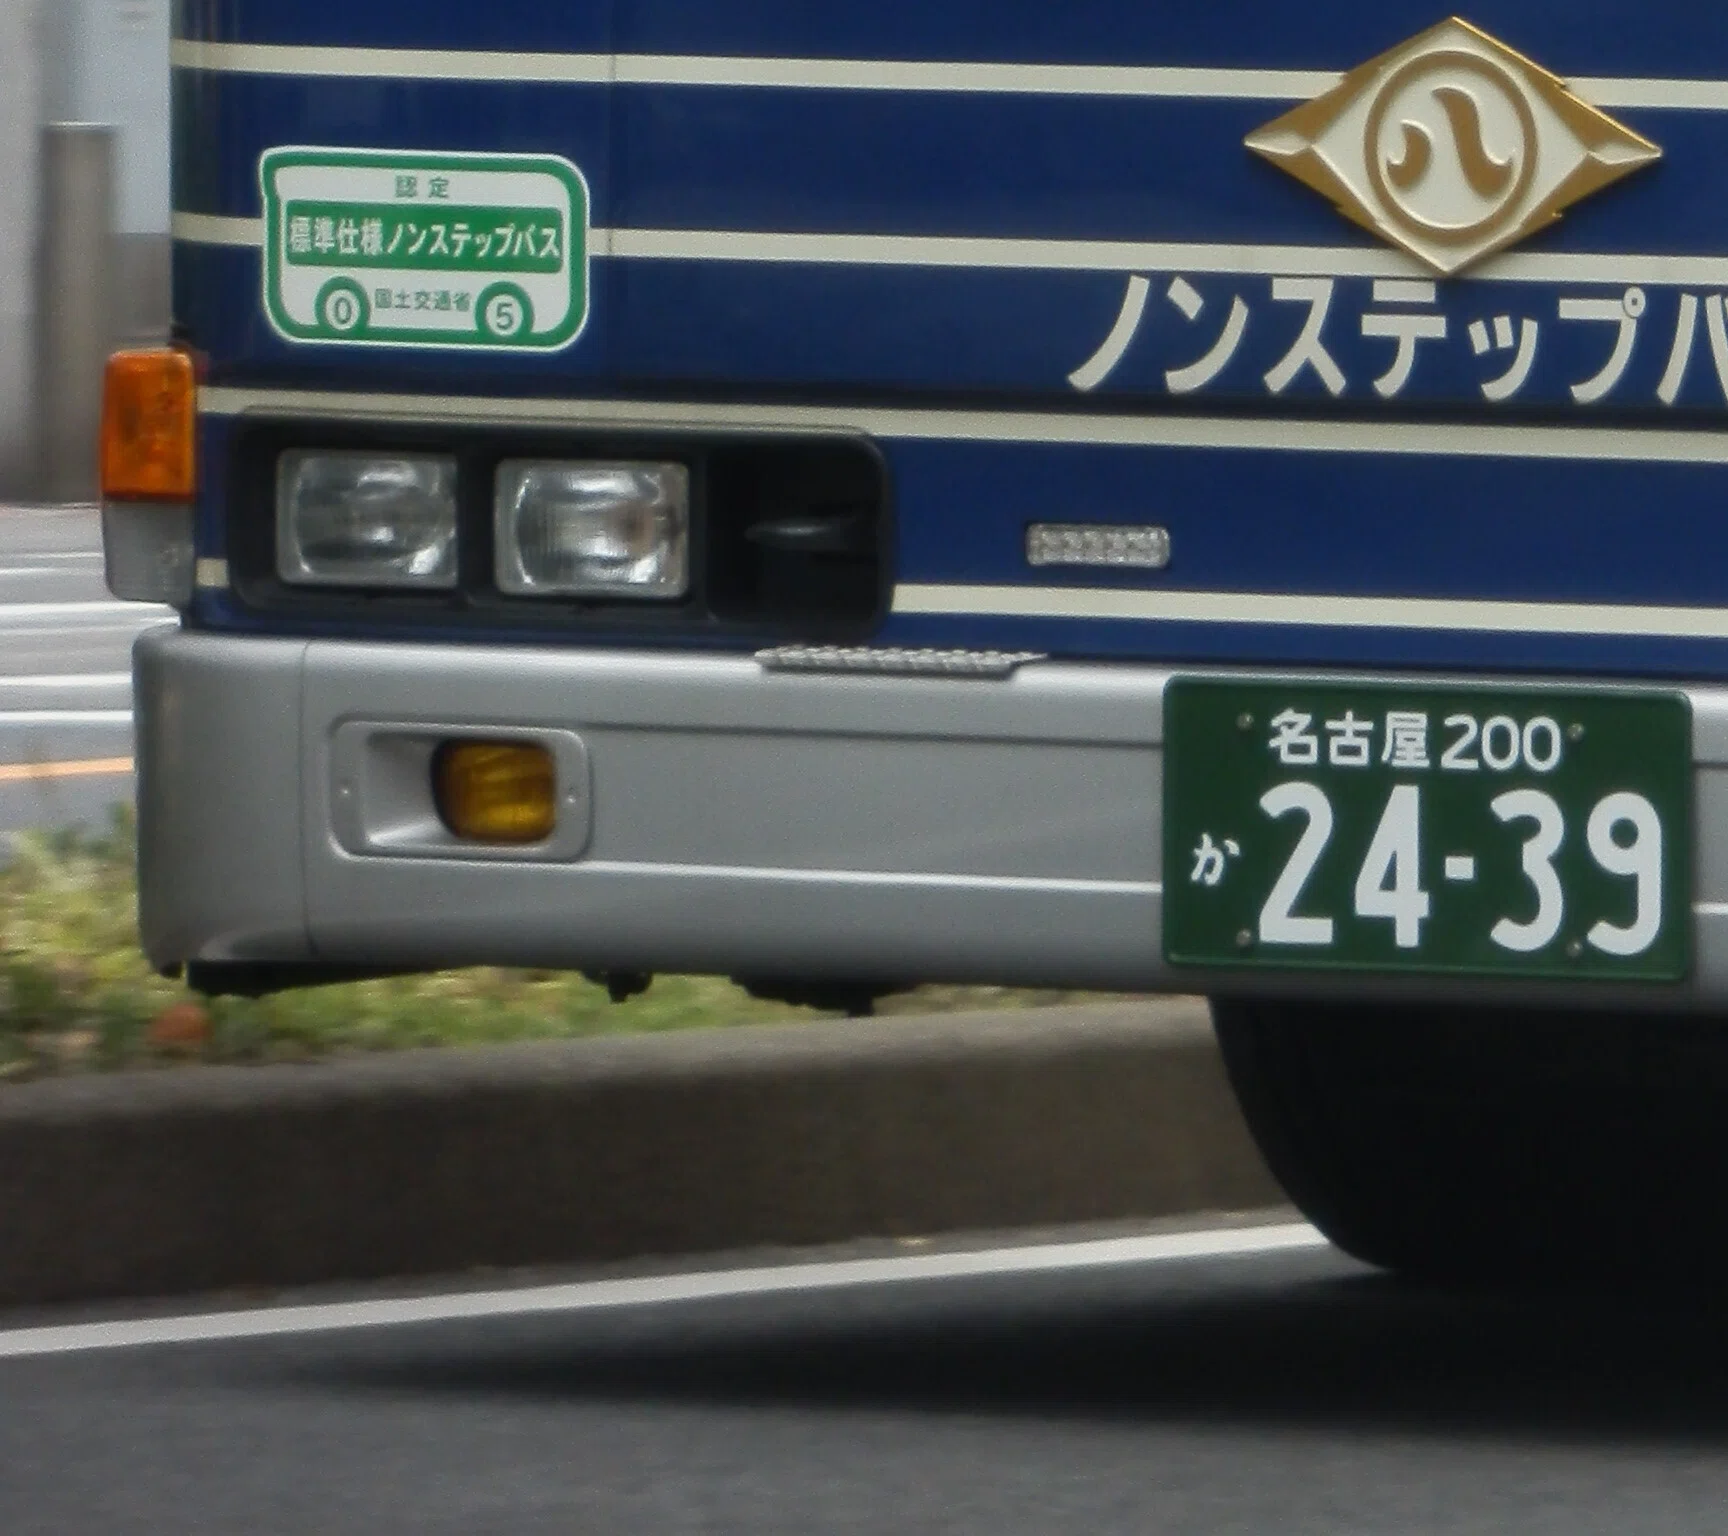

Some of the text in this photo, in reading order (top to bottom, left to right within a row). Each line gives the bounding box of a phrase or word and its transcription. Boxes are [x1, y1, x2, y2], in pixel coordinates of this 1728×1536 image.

[494, 301, 515, 330] 5
[1267, 707, 1563, 773] 名古屋 200
[1190, 780, 1663, 957] か 24-39
